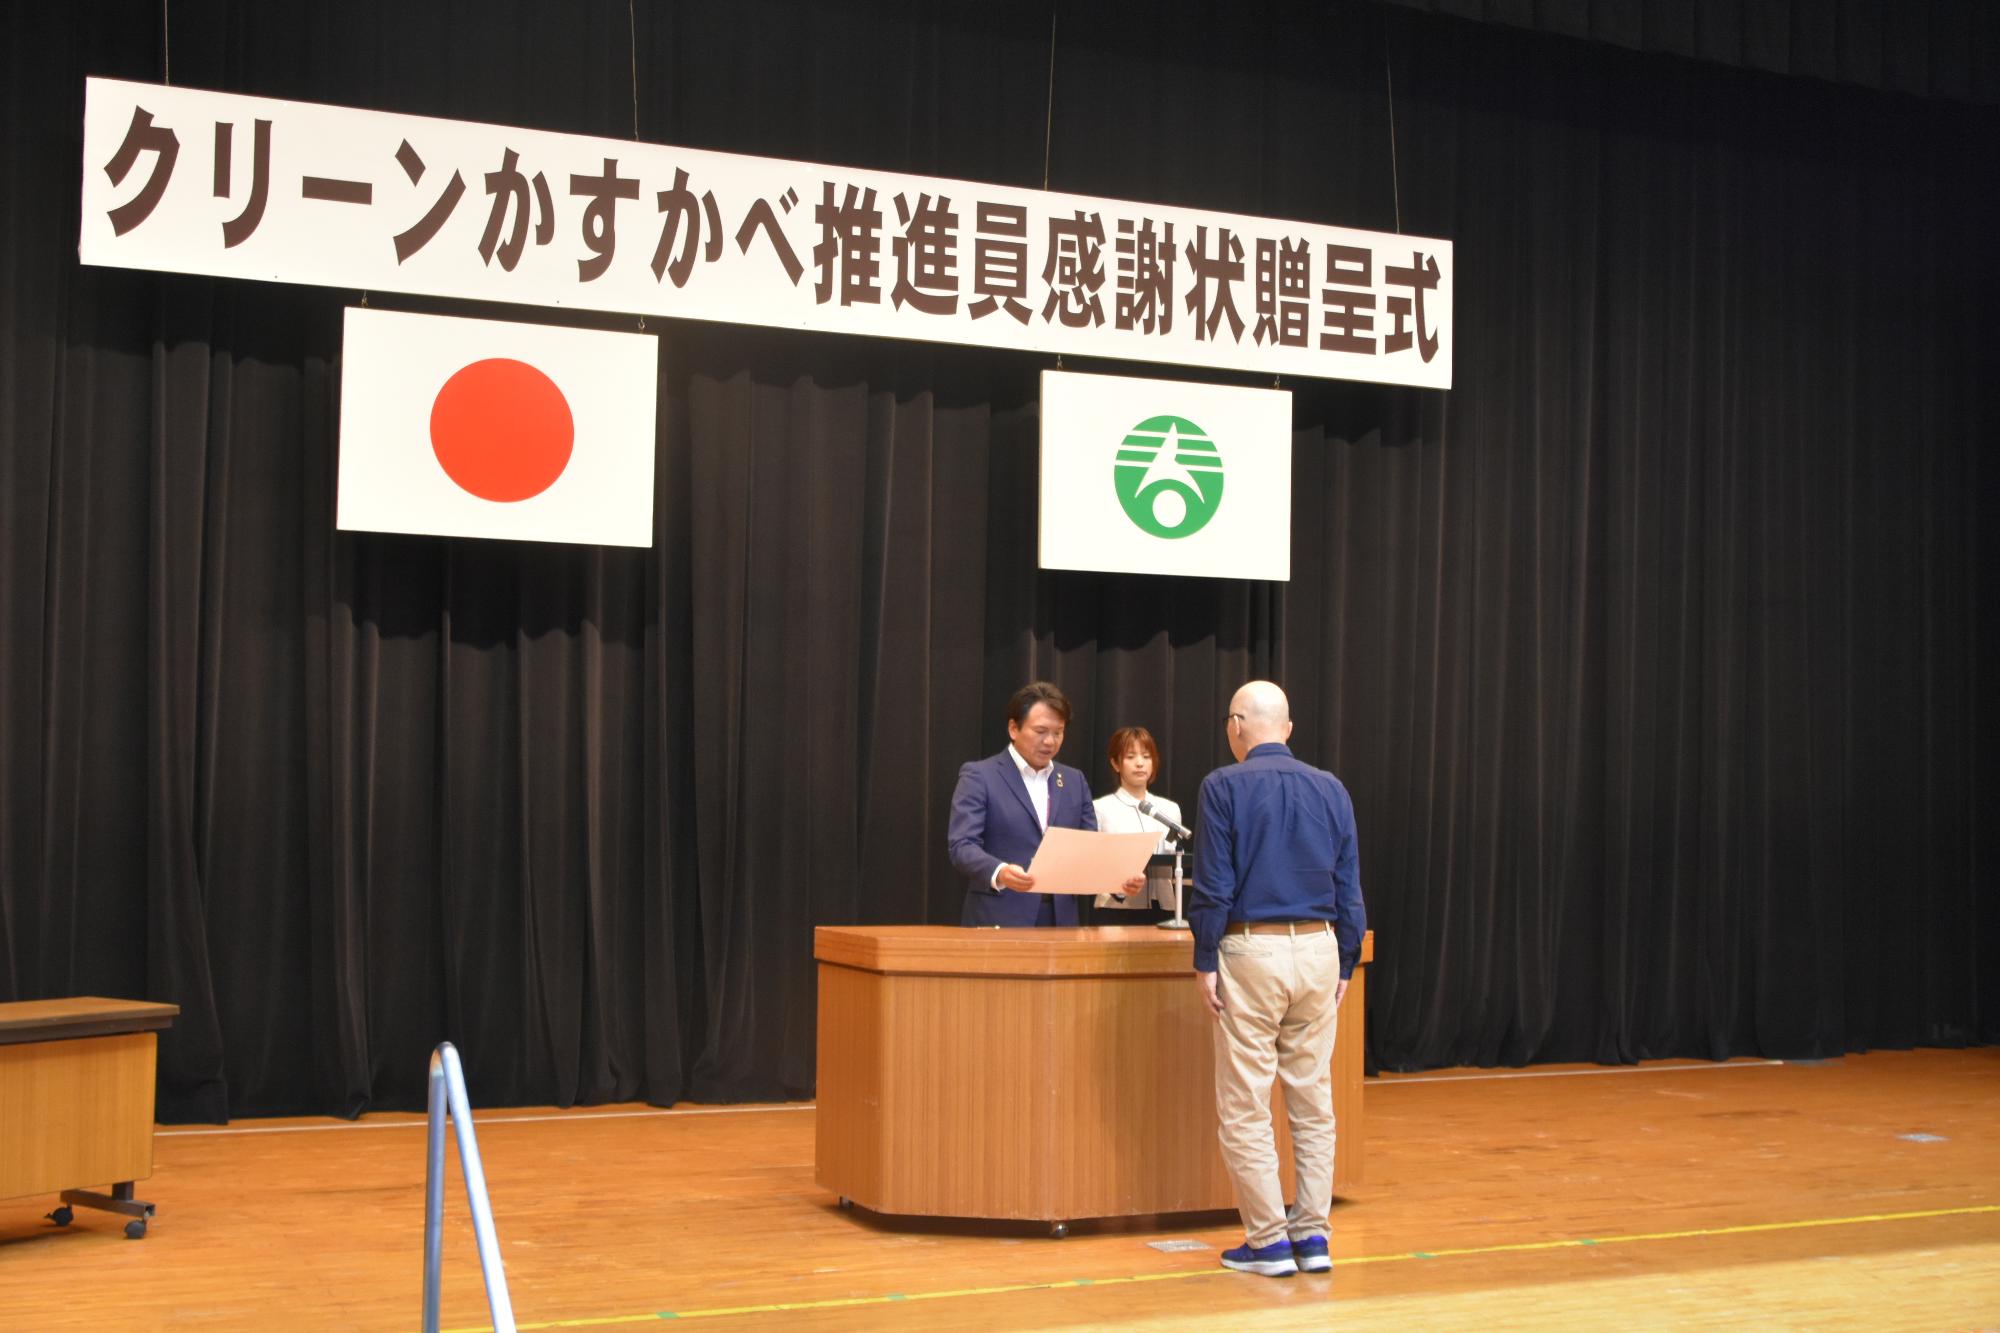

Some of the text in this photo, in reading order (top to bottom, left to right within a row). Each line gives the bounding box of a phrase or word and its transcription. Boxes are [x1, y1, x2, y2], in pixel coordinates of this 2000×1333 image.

[104, 105, 1441, 363] クリーンかすかべ推進員感謝状贈呈式
